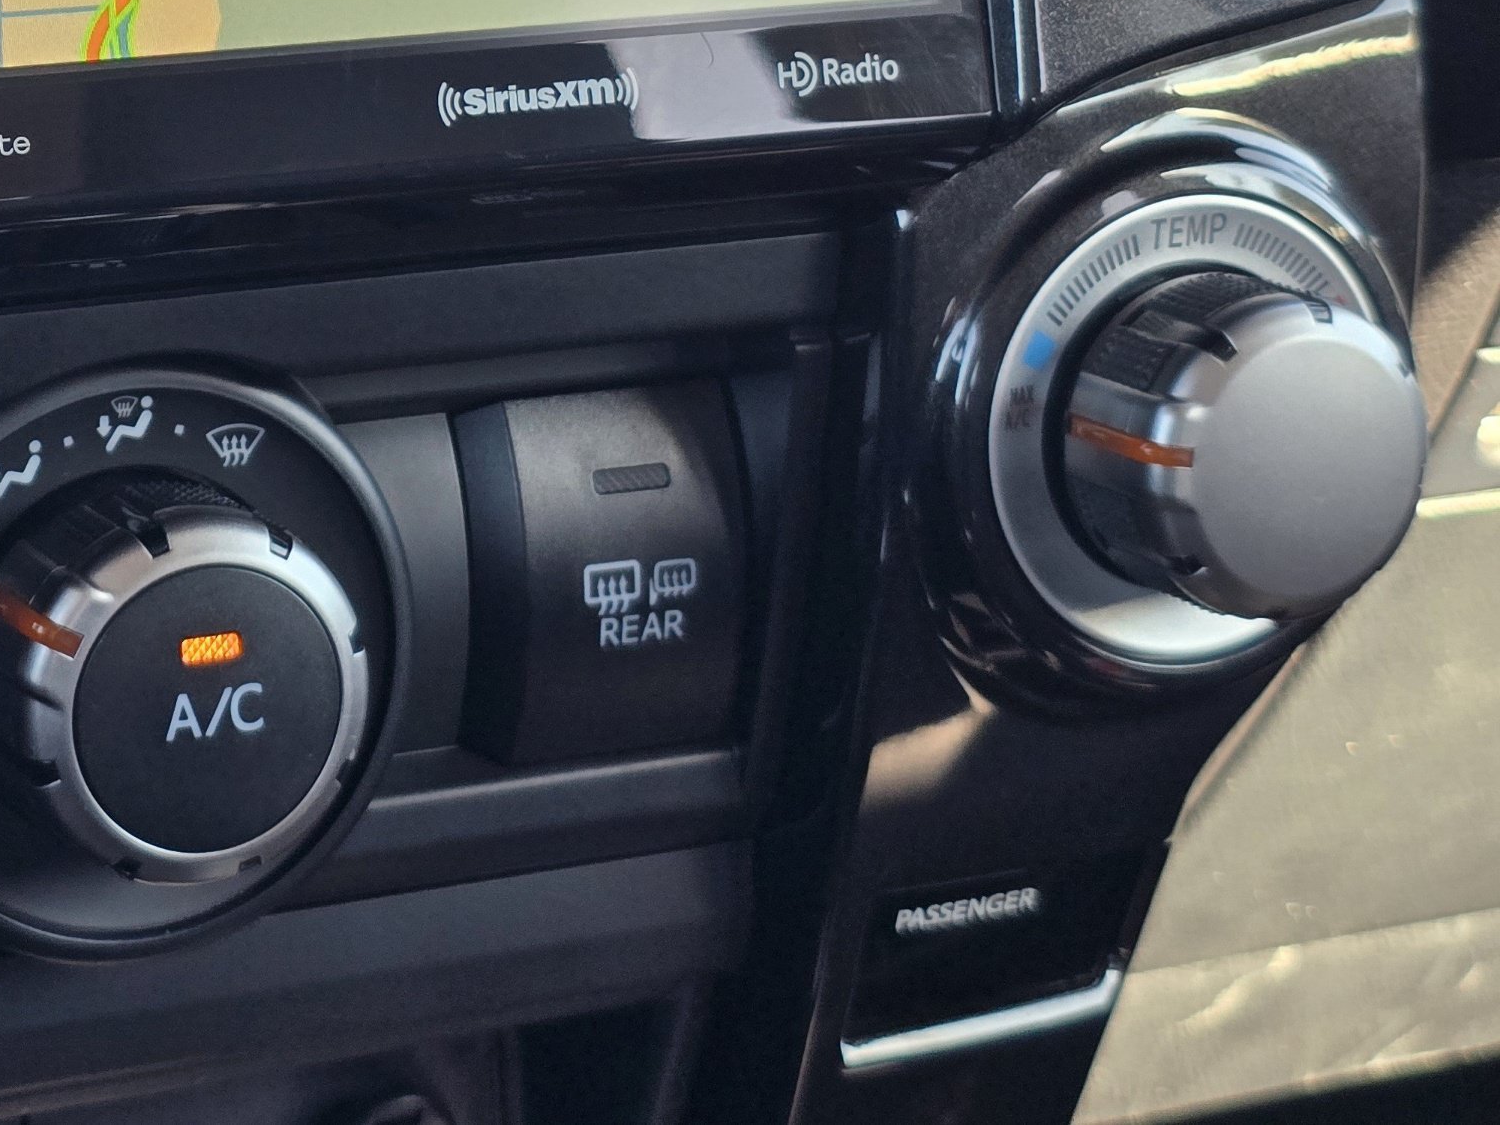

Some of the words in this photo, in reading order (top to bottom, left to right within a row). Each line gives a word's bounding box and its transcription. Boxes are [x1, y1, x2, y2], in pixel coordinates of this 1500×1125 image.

[822, 53, 899, 86] Radio
[1151, 213, 1228, 250] TEMP
[600, 610, 685, 648] REAR
[166, 683, 265, 743] A/C
[895, 887, 1040, 934] PASSENGER
